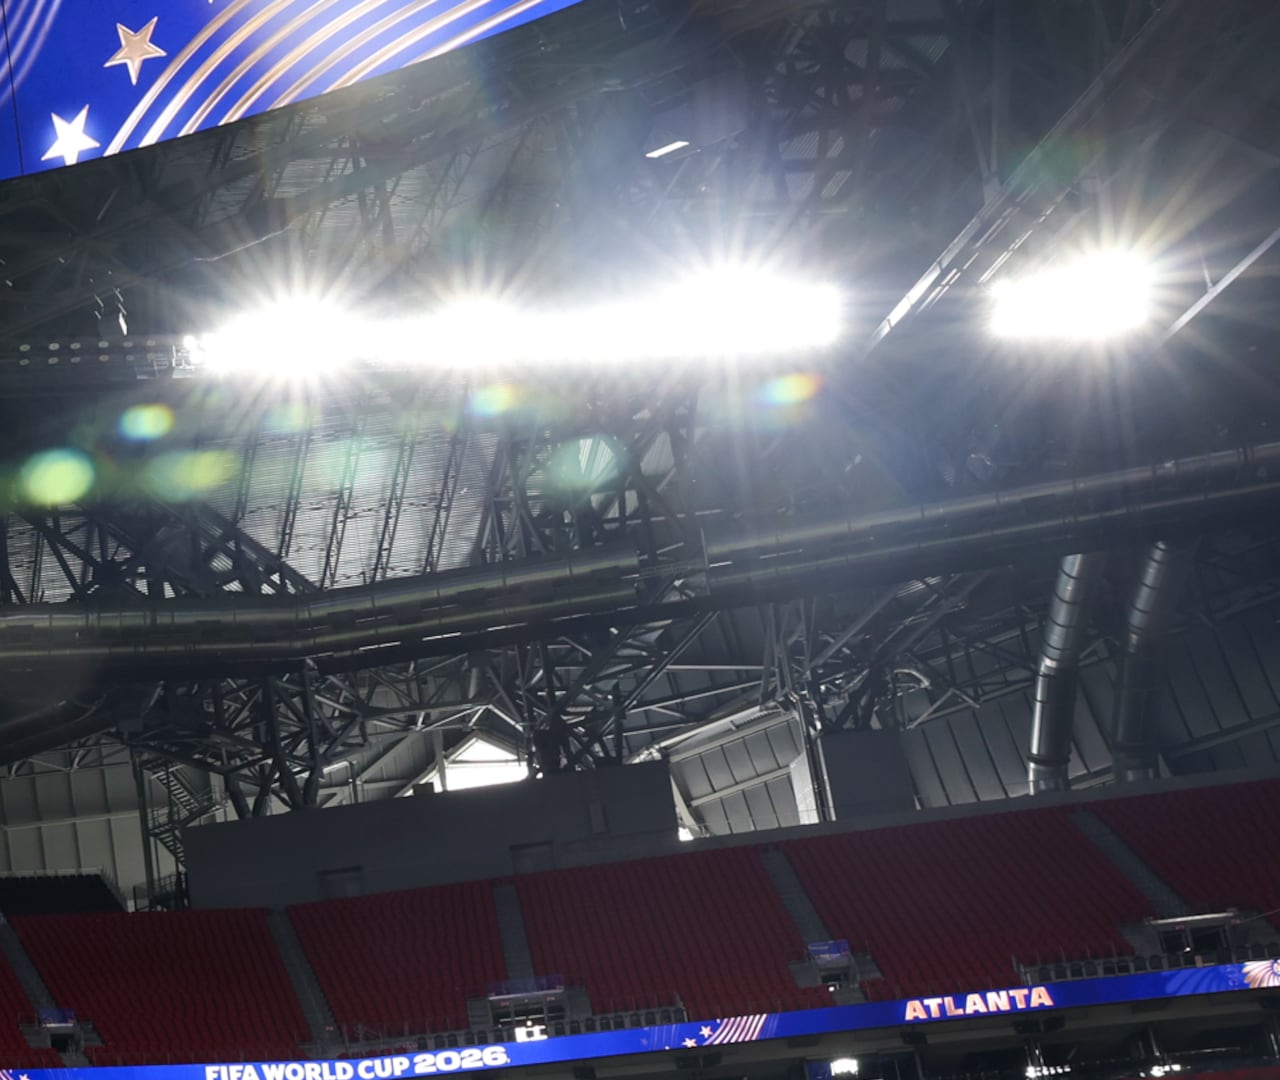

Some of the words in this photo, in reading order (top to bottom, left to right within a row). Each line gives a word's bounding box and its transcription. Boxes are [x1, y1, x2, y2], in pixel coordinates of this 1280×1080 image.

[905, 987, 1053, 1020] ATLANTA
[357, 1056, 411, 1080] CUP
[413, 1046, 507, 1073] 2026
